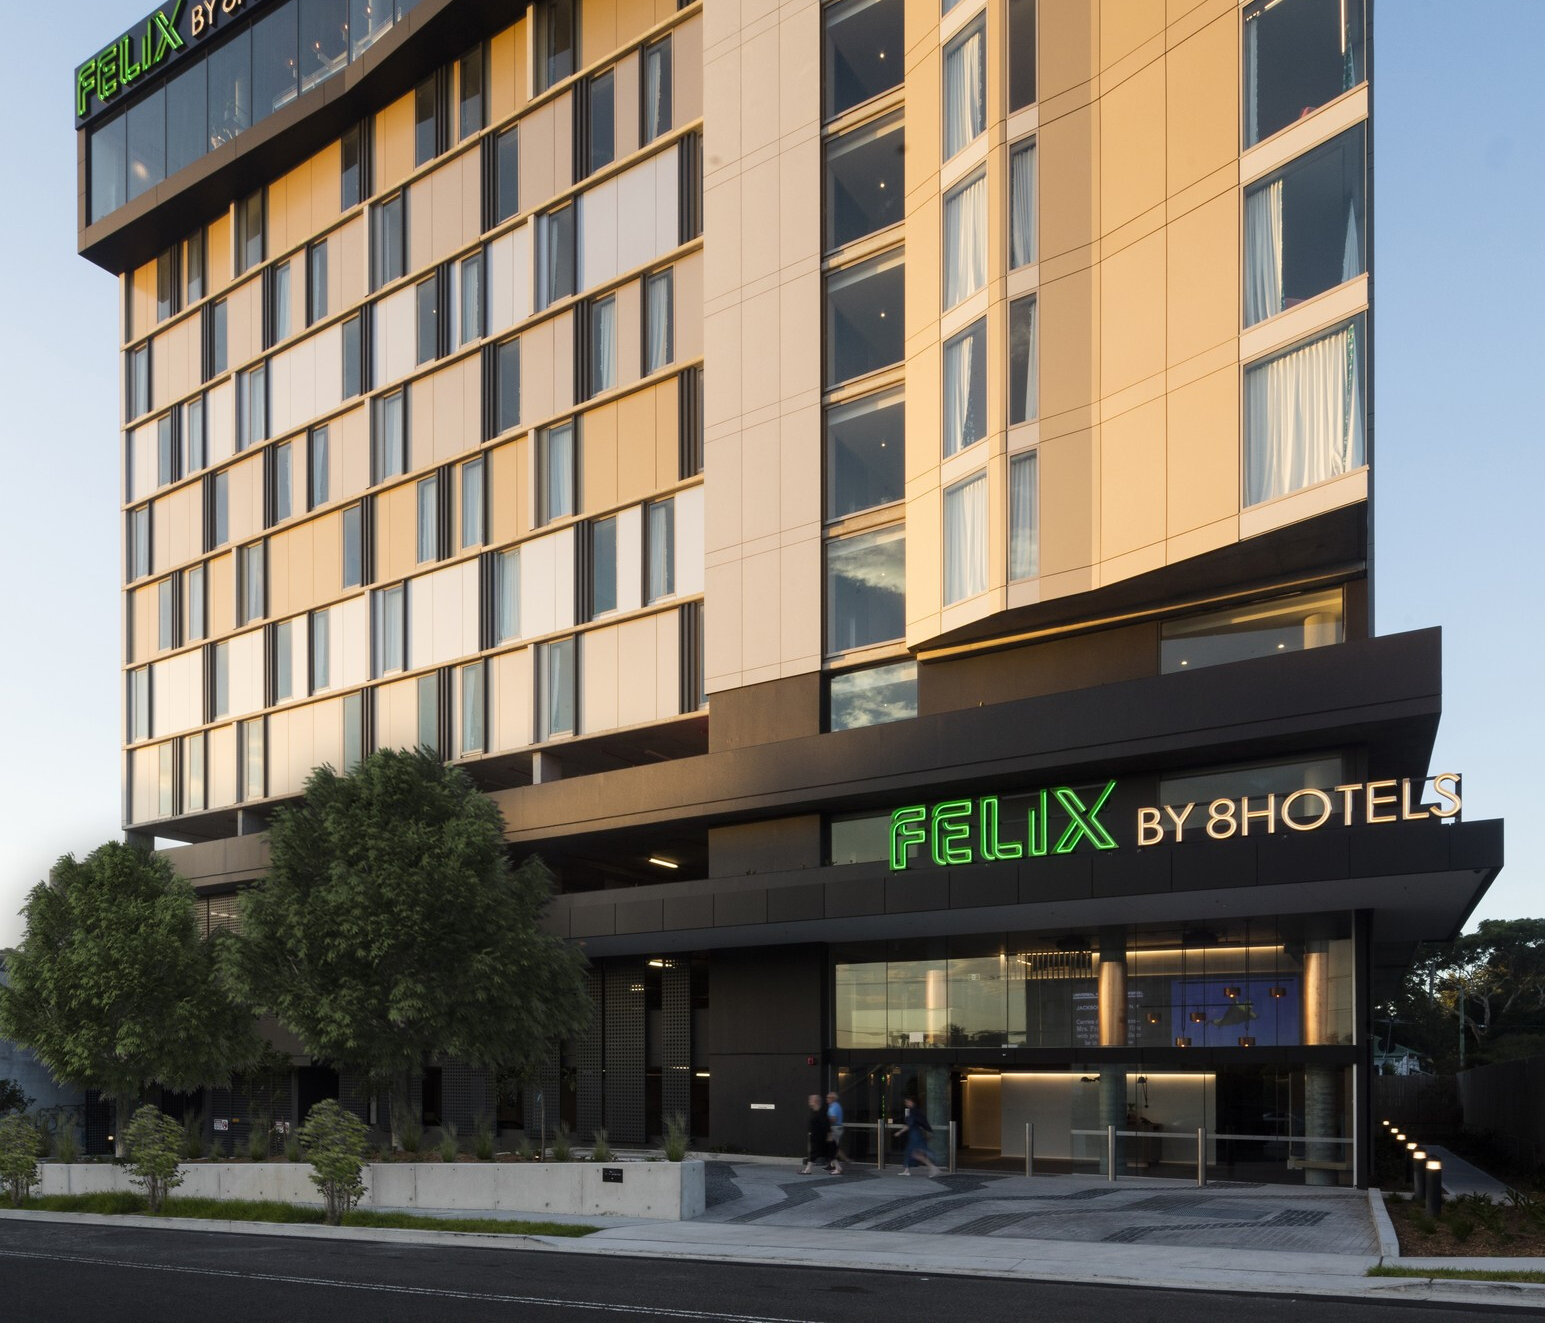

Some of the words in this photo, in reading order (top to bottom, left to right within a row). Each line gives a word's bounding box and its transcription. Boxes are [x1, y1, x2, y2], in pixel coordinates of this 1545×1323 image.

[889, 779, 1119, 871] FELIX
[1138, 802, 1195, 846] BY
[1206, 773, 1462, 839] 8HOTELS
